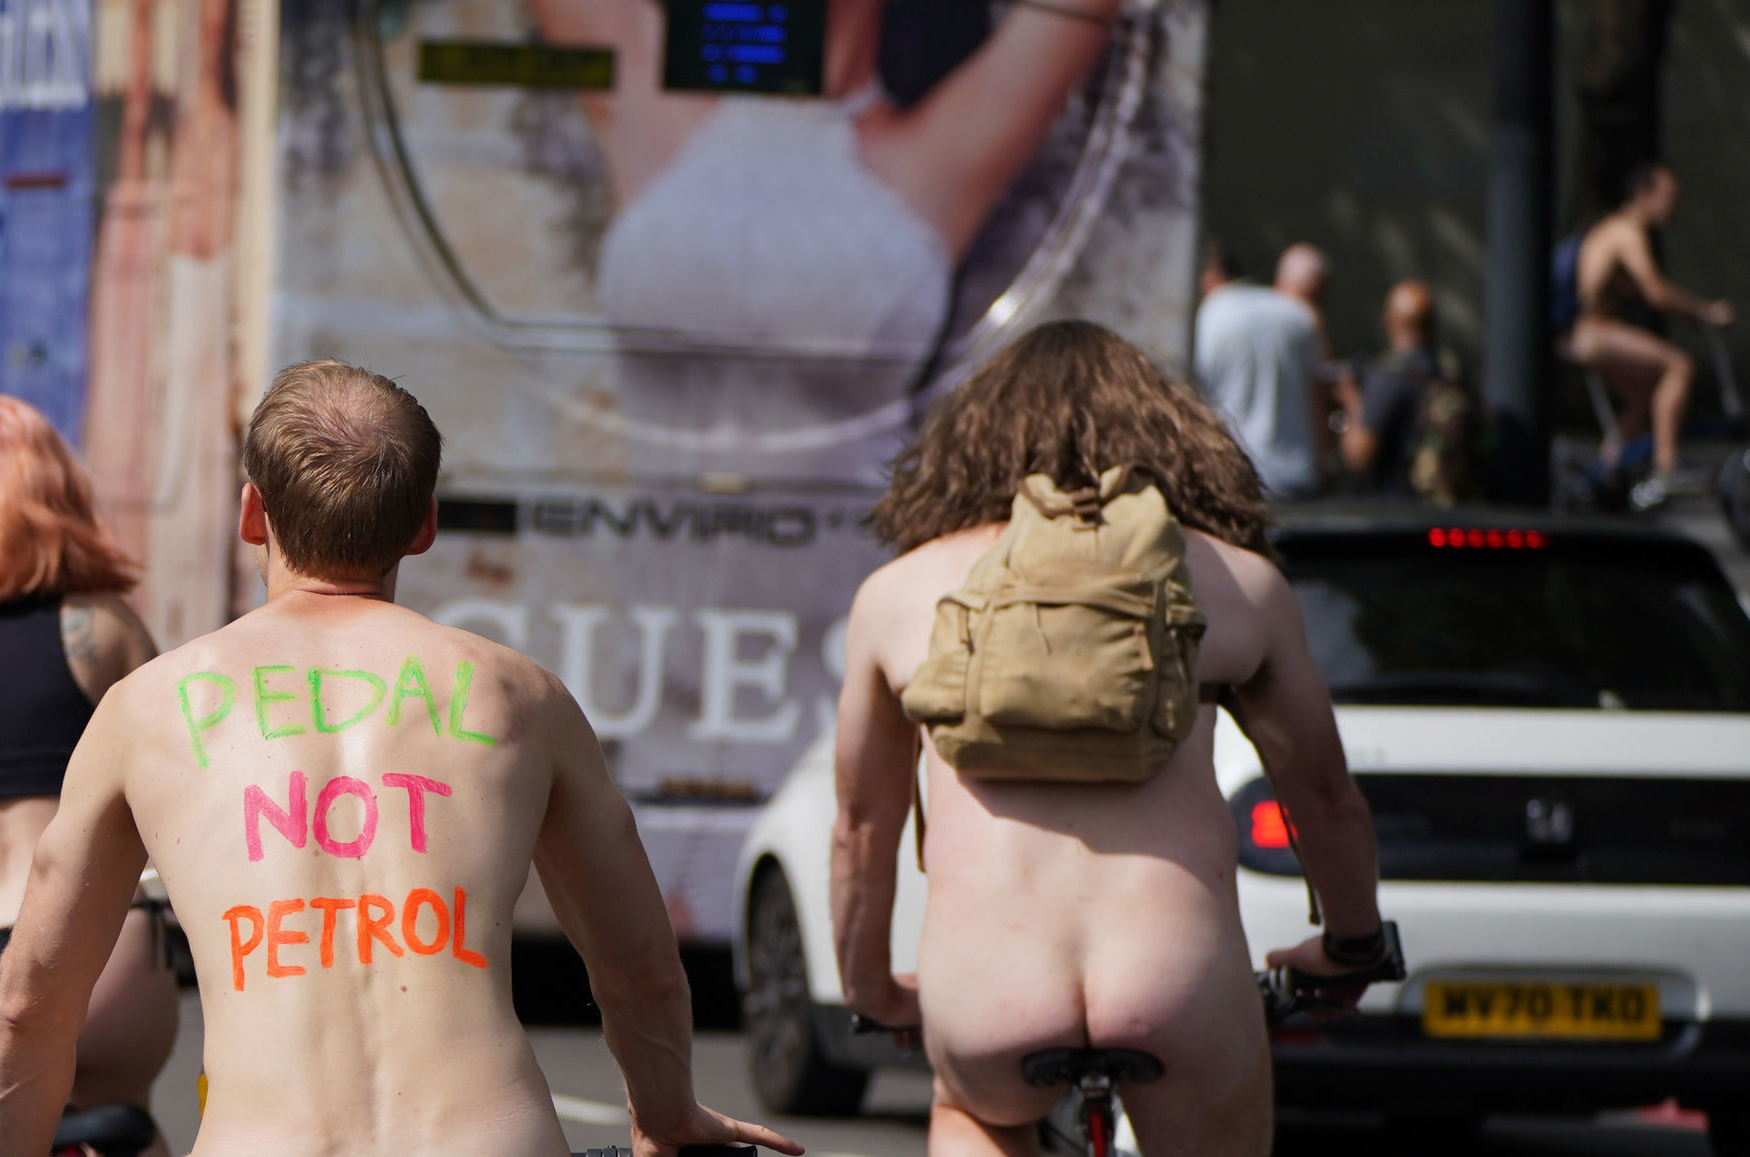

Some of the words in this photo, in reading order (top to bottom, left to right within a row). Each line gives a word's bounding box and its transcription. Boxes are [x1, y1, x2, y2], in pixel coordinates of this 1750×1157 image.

[176, 653, 498, 769] PEDAL
[243, 770, 452, 862] NOT
[222, 885, 490, 992] PETROL
